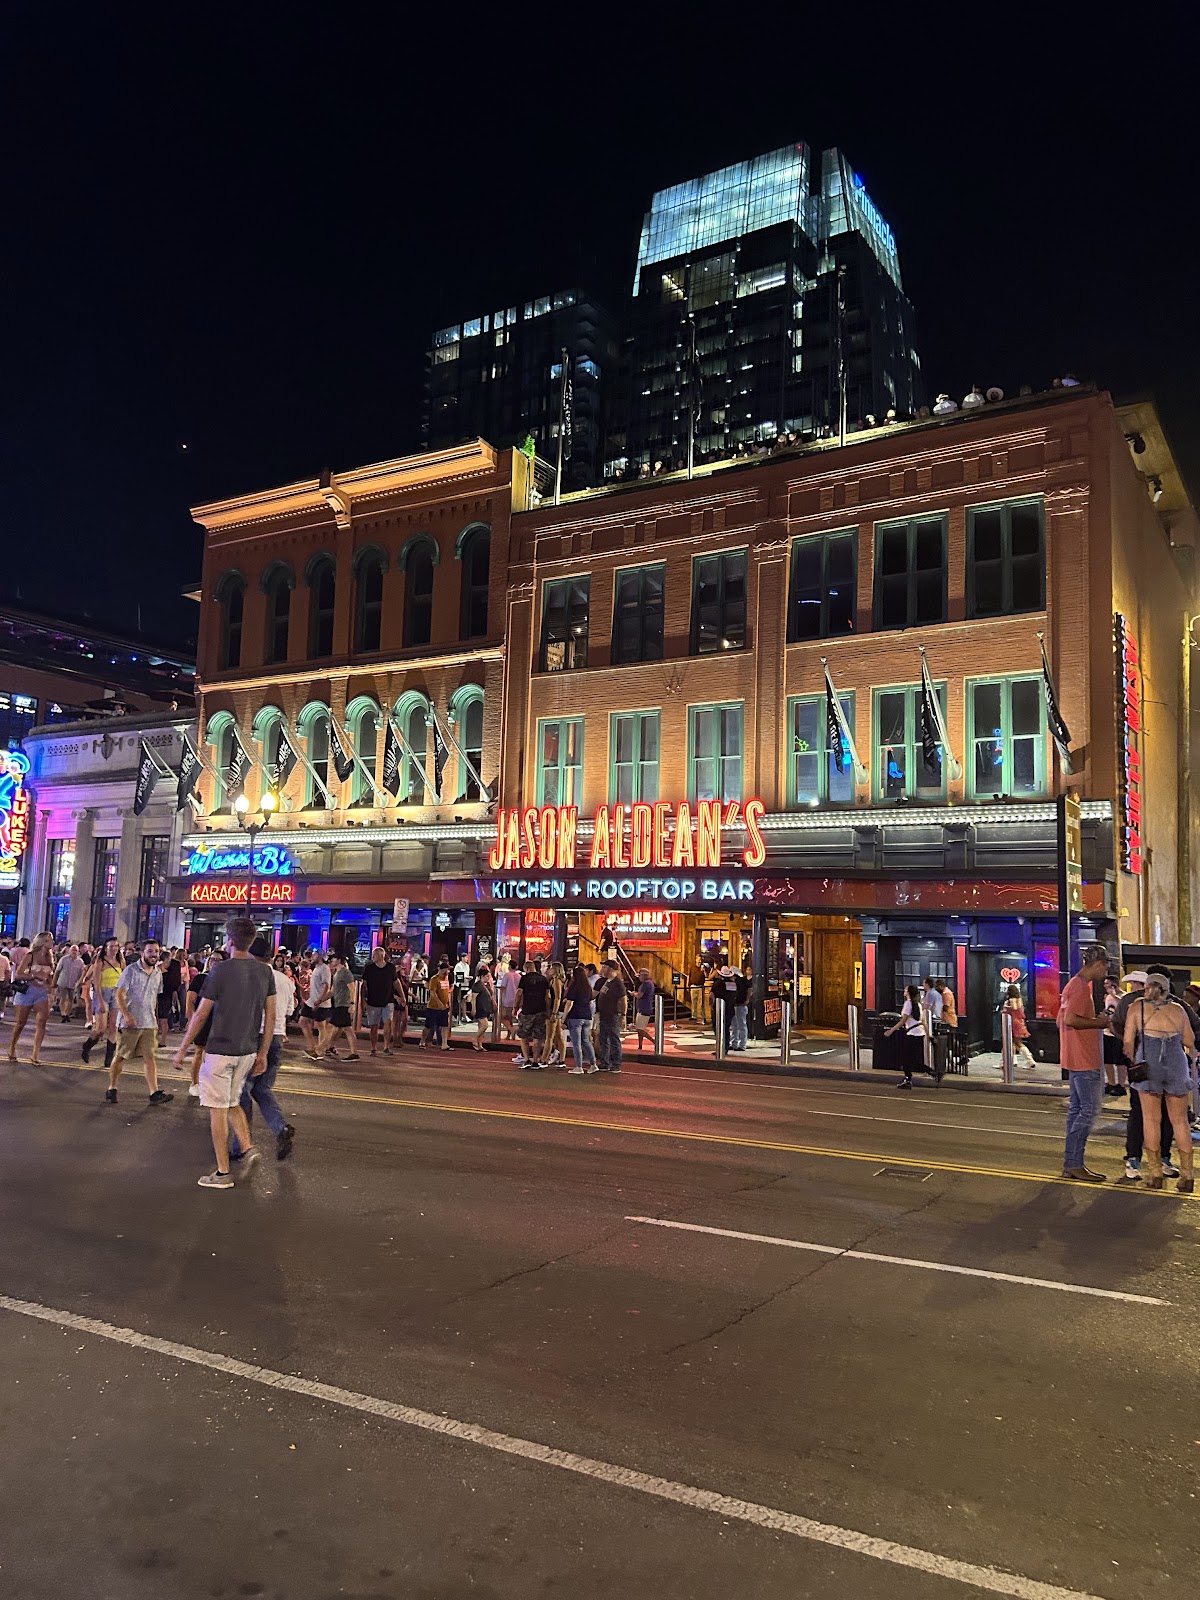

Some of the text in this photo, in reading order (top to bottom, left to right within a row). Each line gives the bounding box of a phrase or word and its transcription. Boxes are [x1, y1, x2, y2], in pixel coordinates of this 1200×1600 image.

[489, 798, 767, 869] JASON ALDEAN'S
[191, 884, 293, 901] KARAOKE BAR
[491, 880, 755, 901] KITCHEN + ROOFTOP BAR
